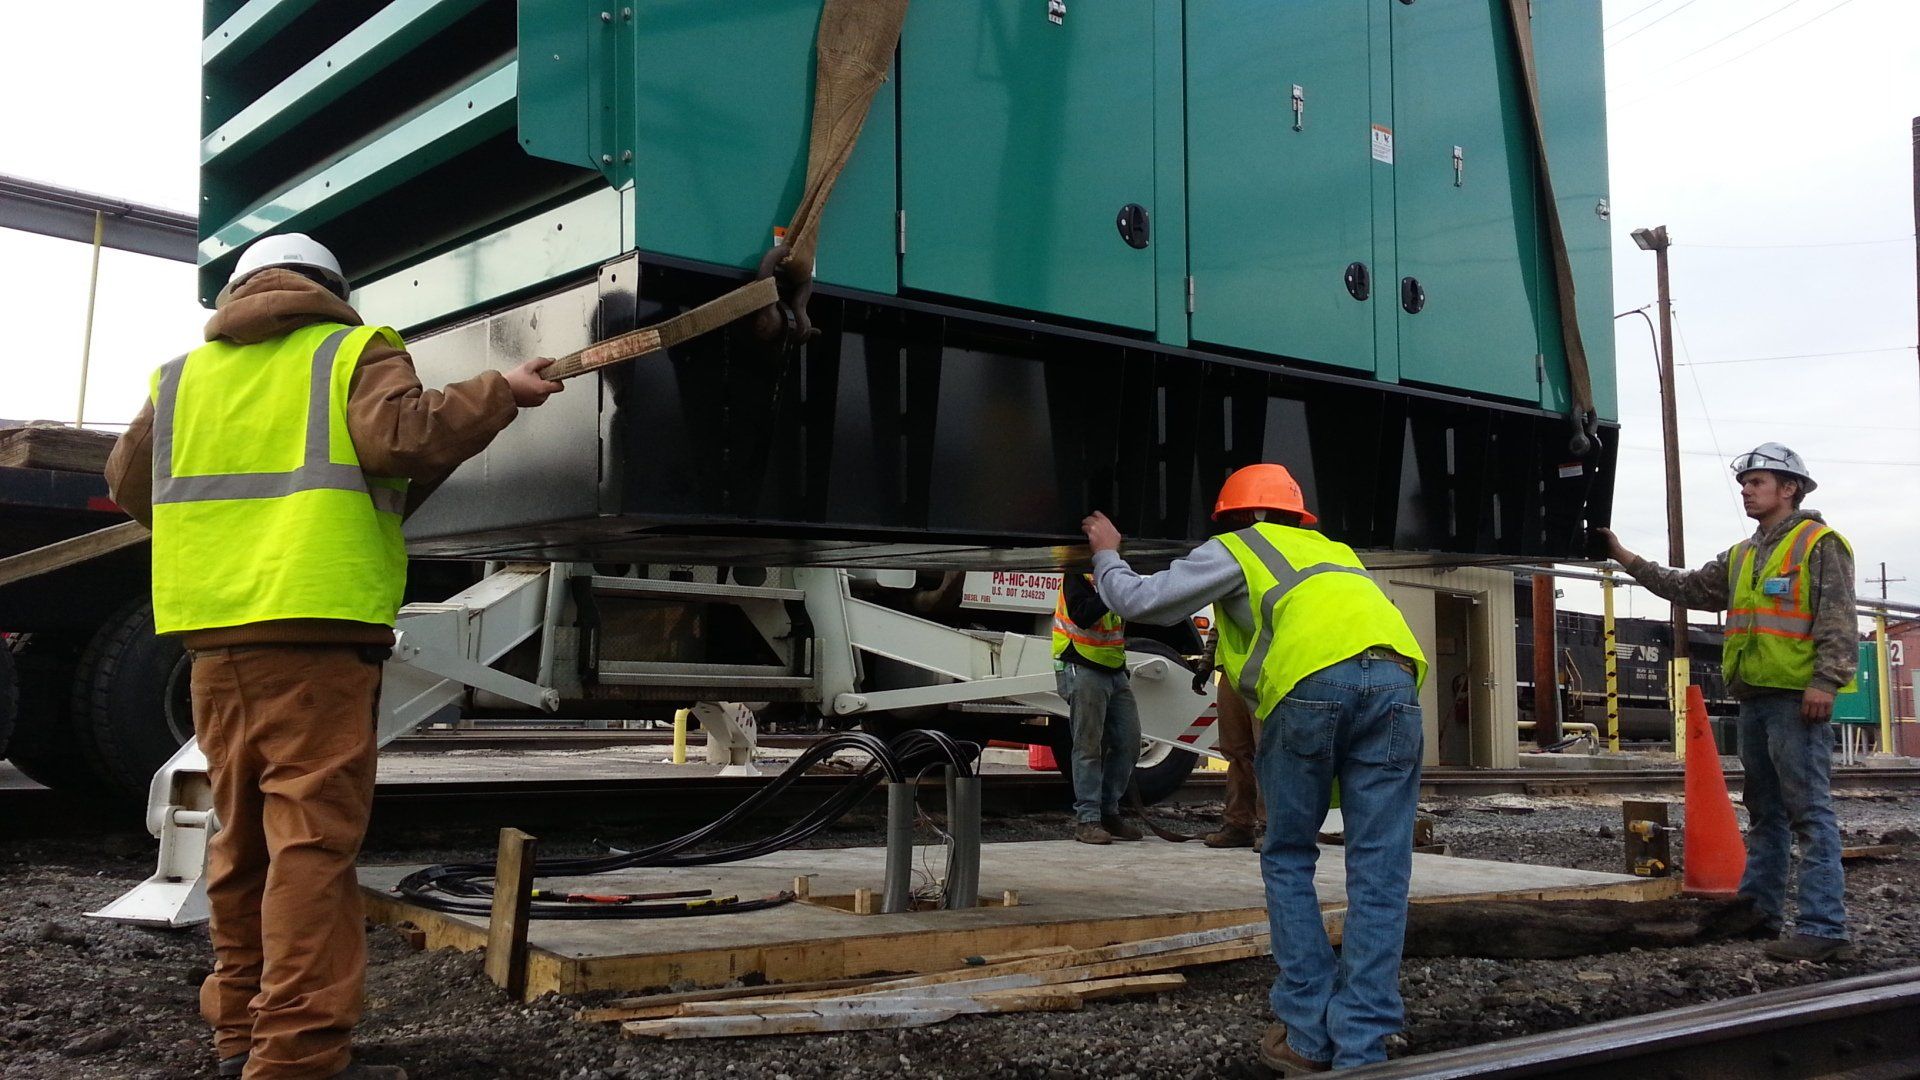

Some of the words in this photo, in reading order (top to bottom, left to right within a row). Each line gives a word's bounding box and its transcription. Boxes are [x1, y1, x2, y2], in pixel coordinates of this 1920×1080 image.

[964, 593, 978, 602] DIESEL
[980, 595, 991, 603] FUEL
[991, 586, 1002, 596] U.S.
[1006, 588, 1018, 598] DOT
[1891, 643, 1900, 661] 2
